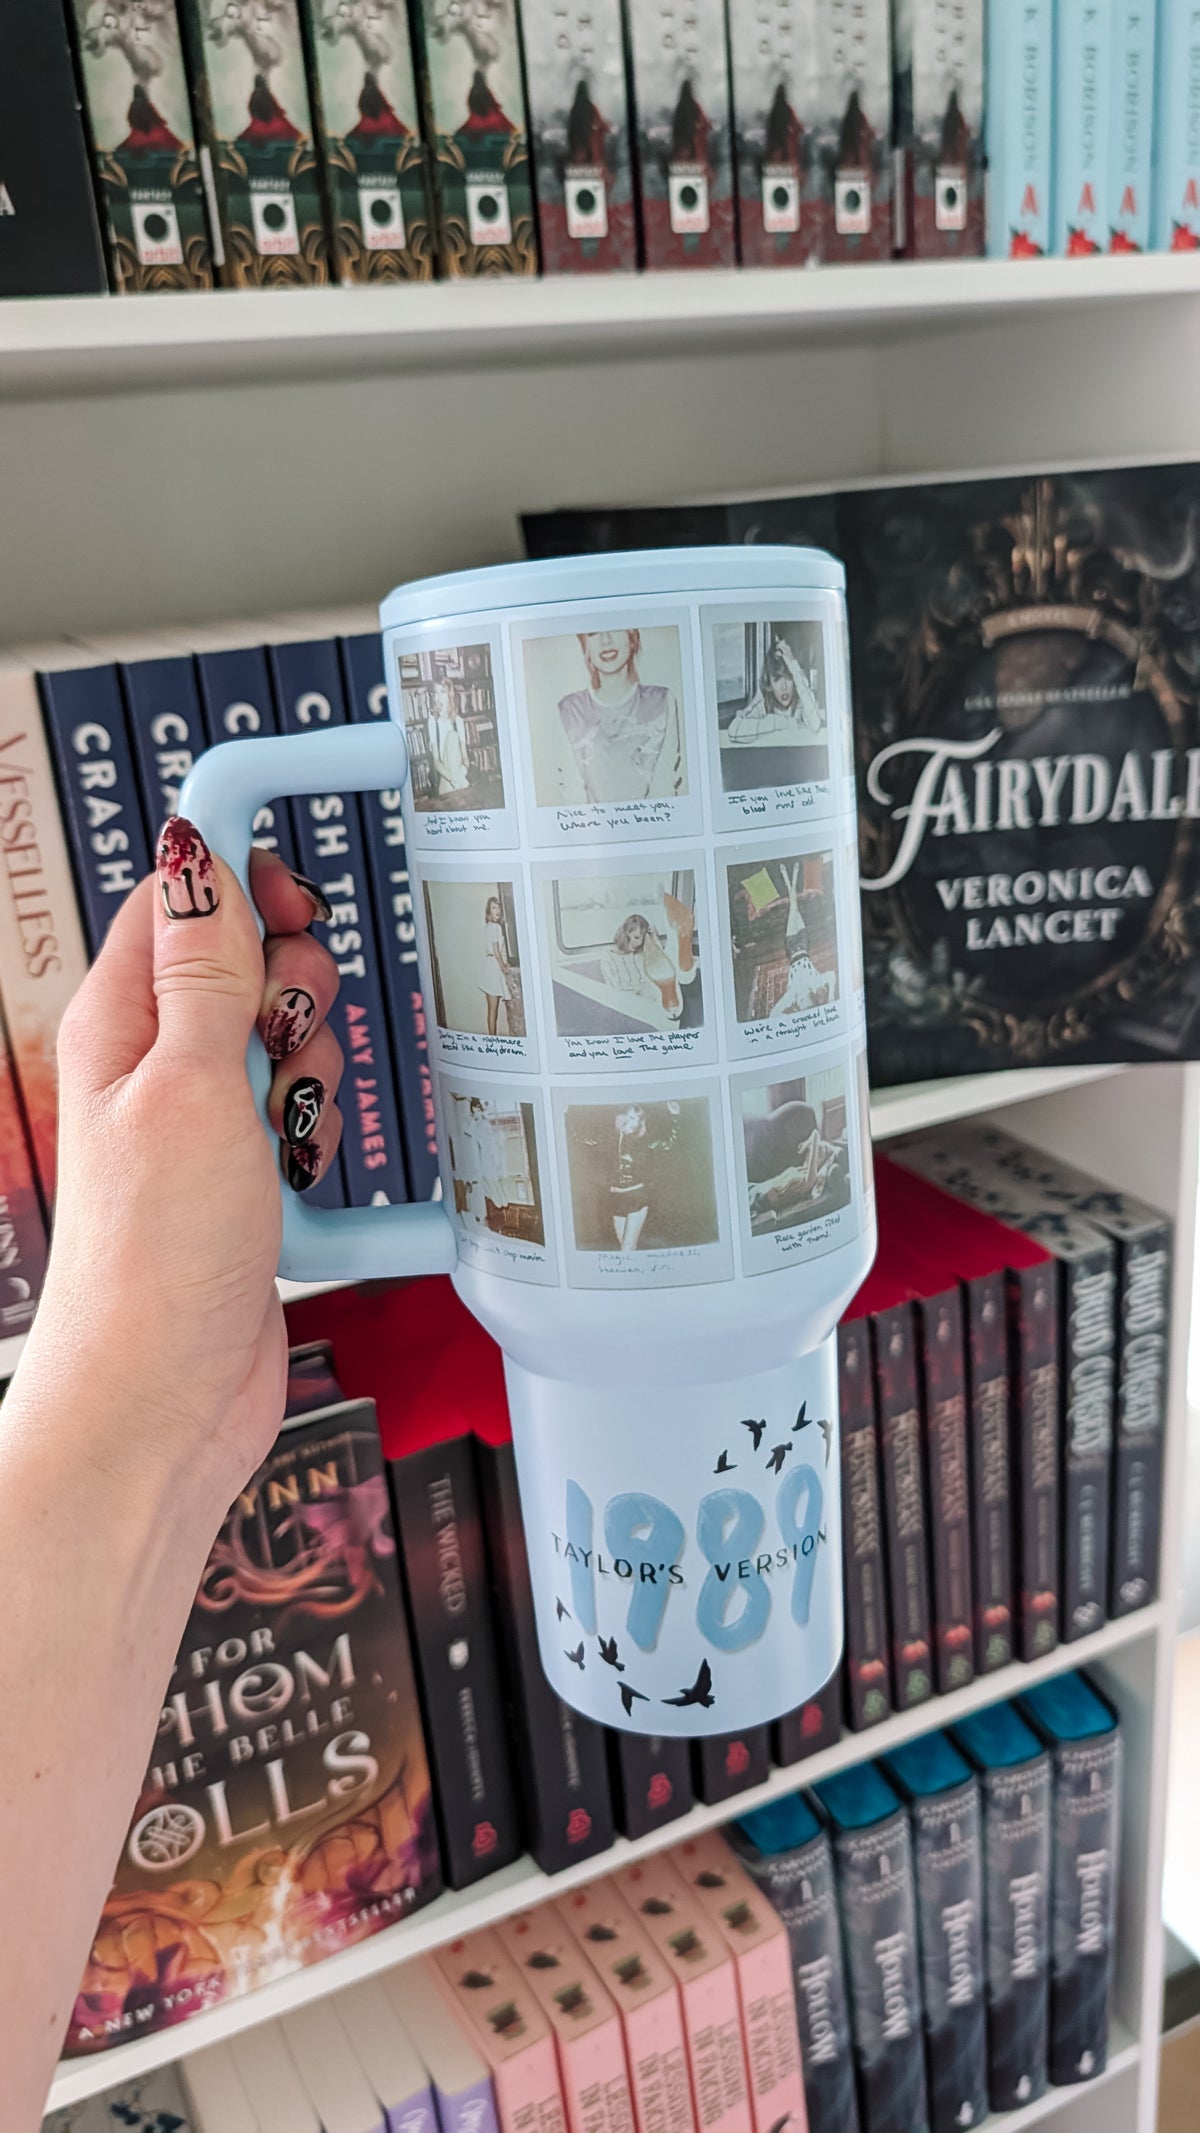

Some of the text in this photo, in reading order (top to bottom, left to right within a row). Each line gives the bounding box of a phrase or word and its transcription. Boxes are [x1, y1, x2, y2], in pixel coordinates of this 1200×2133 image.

[73, 721, 136, 894] CRASH
[557, 810, 586, 820] Nice
[591, 806, 606, 814] to
[614, 803, 647, 812] meet
[606, 818, 630, 829] you
[634, 812, 671, 823] been?
[750, 795, 768, 805] you
[774, 788, 795, 798] love
[936, 864, 1153, 912] VERONICA
[322, 872, 367, 979] TEST
[965, 907, 1124, 951] LANCET
[345, 1003, 375, 1065] AMY
[565, 1038, 582, 1048] You
[585, 1038, 609, 1046] know
[613, 1036, 625, 1044] I
[626, 1035, 645, 1043] love
[569, 1048, 587, 1058] and
[588, 1050, 609, 1059] you
[355, 1077, 388, 1170] JAMES
[1070, 1270, 1116, 1358] DRUID
[1123, 1250, 1166, 1335] DRUID
[1067, 1355, 1115, 1453] CURSED
[1119, 1333, 1166, 1434] CURSED
[239, 1461, 339, 1517] YNN
[428, 1475, 467, 1614] THE WICKED
[551, 1526, 829, 1585] TAYLOR'S VERSION
[566, 1463, 824, 1653] 1989
[191, 1627, 276, 1679] FOR
[151, 1697, 355, 1790] HE BELLE
[128, 1730, 379, 1873] OLLS
[105, 2003, 155, 2034] NEW
[163, 1975, 222, 2010] YORK
